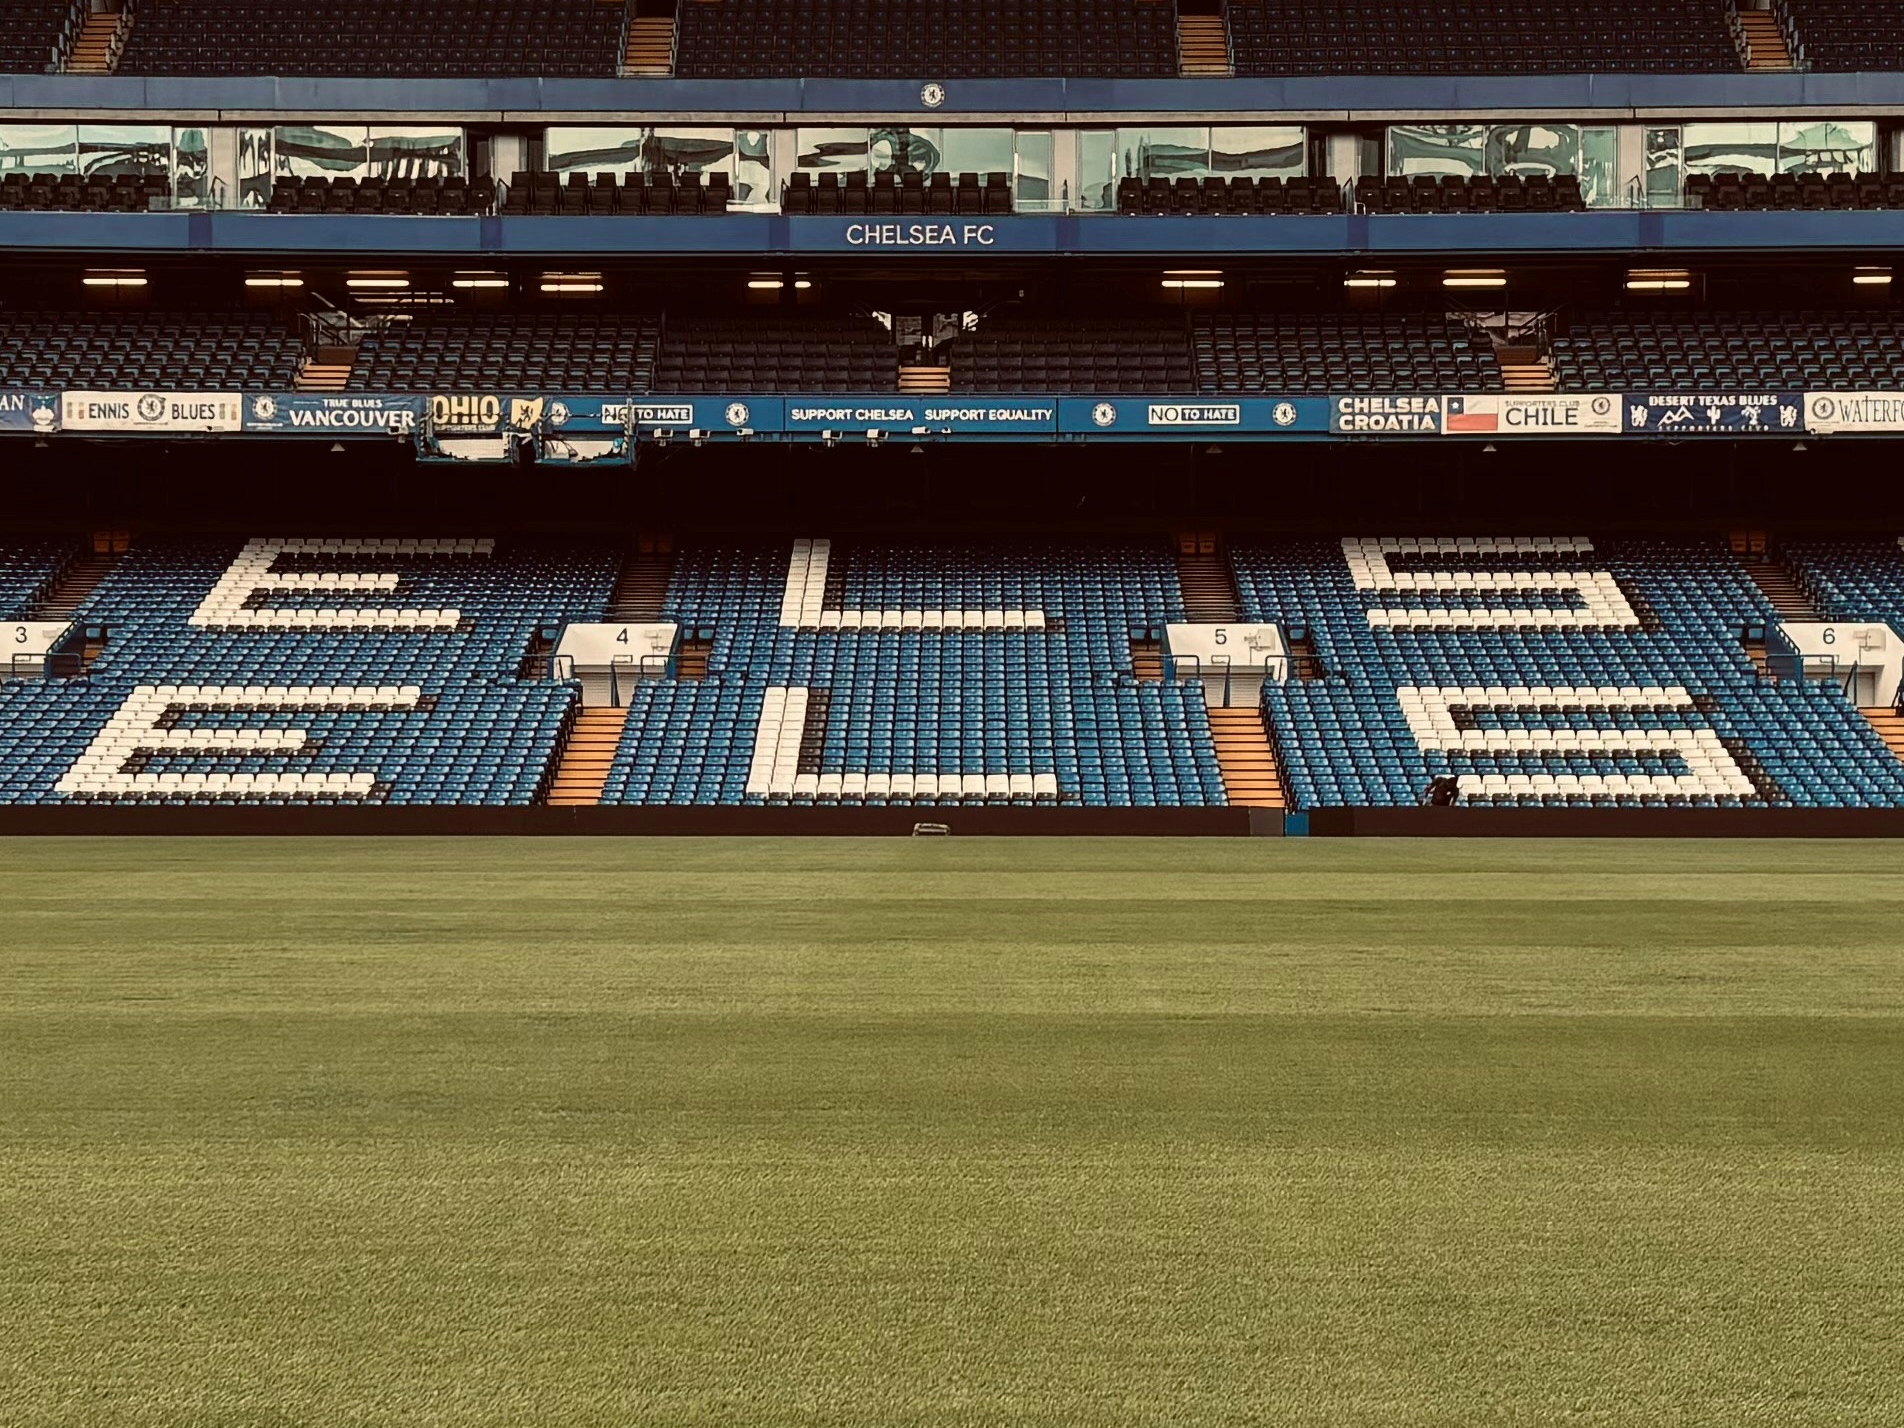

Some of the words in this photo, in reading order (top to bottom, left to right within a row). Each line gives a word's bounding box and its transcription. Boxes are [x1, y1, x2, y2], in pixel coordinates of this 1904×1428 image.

[846, 224, 956, 245] CHELSEA
[963, 224, 994, 245] FC
[322, 399, 349, 409] TRUE
[351, 399, 383, 409] BLUES
[1338, 397, 1439, 413] CHELSEA
[1648, 395, 1696, 406] DESERT
[1698, 395, 1736, 406] TEXAS
[1739, 395, 1778, 406] BLUES
[89, 403, 130, 420] ENNIS
[171, 403, 215, 420] BLUES
[433, 395, 500, 425] OHIO
[636, 409, 654, 420] TO
[657, 409, 689, 420] HATE
[791, 409, 853, 421] SUPPORT
[855, 409, 914, 421] CHELSEA
[924, 409, 985, 421] SUPPORT
[989, 408, 1053, 422] EQUALITY
[1151, 407, 1179, 422] NO
[1183, 409, 1199, 420] TO
[1203, 409, 1236, 420] HATE
[1505, 407, 1579, 426] CHILE
[289, 410, 416, 428] VANCOUVER
[1338, 414, 1436, 431] CROATIA
[15, 626, 28, 644] 3
[616, 627, 629, 645] 4
[1215, 628, 1227, 645] 5
[1823, 627, 1836, 644] 6
